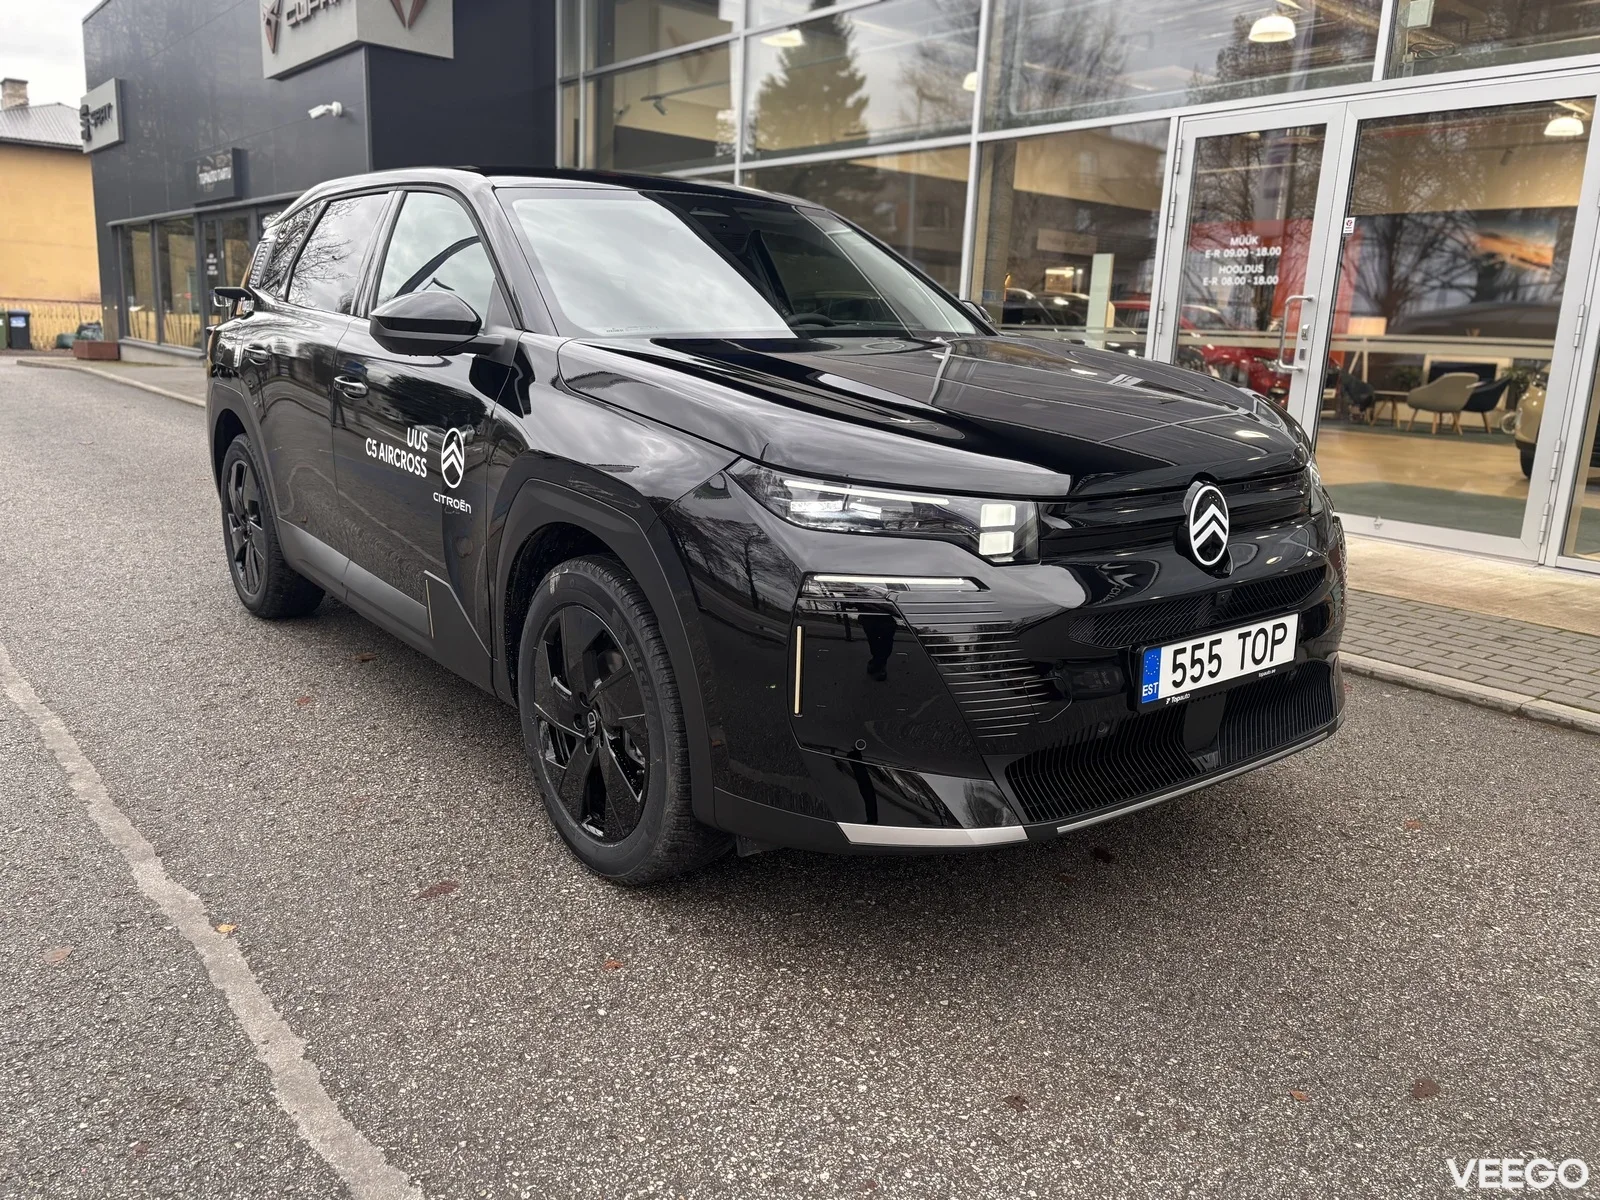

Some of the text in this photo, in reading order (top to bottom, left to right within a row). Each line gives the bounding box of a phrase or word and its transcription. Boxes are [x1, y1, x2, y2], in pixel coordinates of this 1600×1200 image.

[1230, 234, 1259, 246] MÜÜK
[1205, 249, 1221, 259] E-R
[1223, 248, 1249, 258] 09.00
[1255, 246, 1282, 257] 18.00
[1218, 264, 1265, 275] HOOLDUS
[1202, 277, 1219, 286] E-R
[1253, 275, 1279, 285] 18.00
[406, 427, 428, 453] UUS
[365, 437, 428, 478] C5 AIRCROSS
[432, 491, 472, 514] CITROËN
[1171, 622, 1288, 689] 555 TOP
[1142, 682, 1159, 697] EST
[1171, 692, 1191, 704] Topauto
